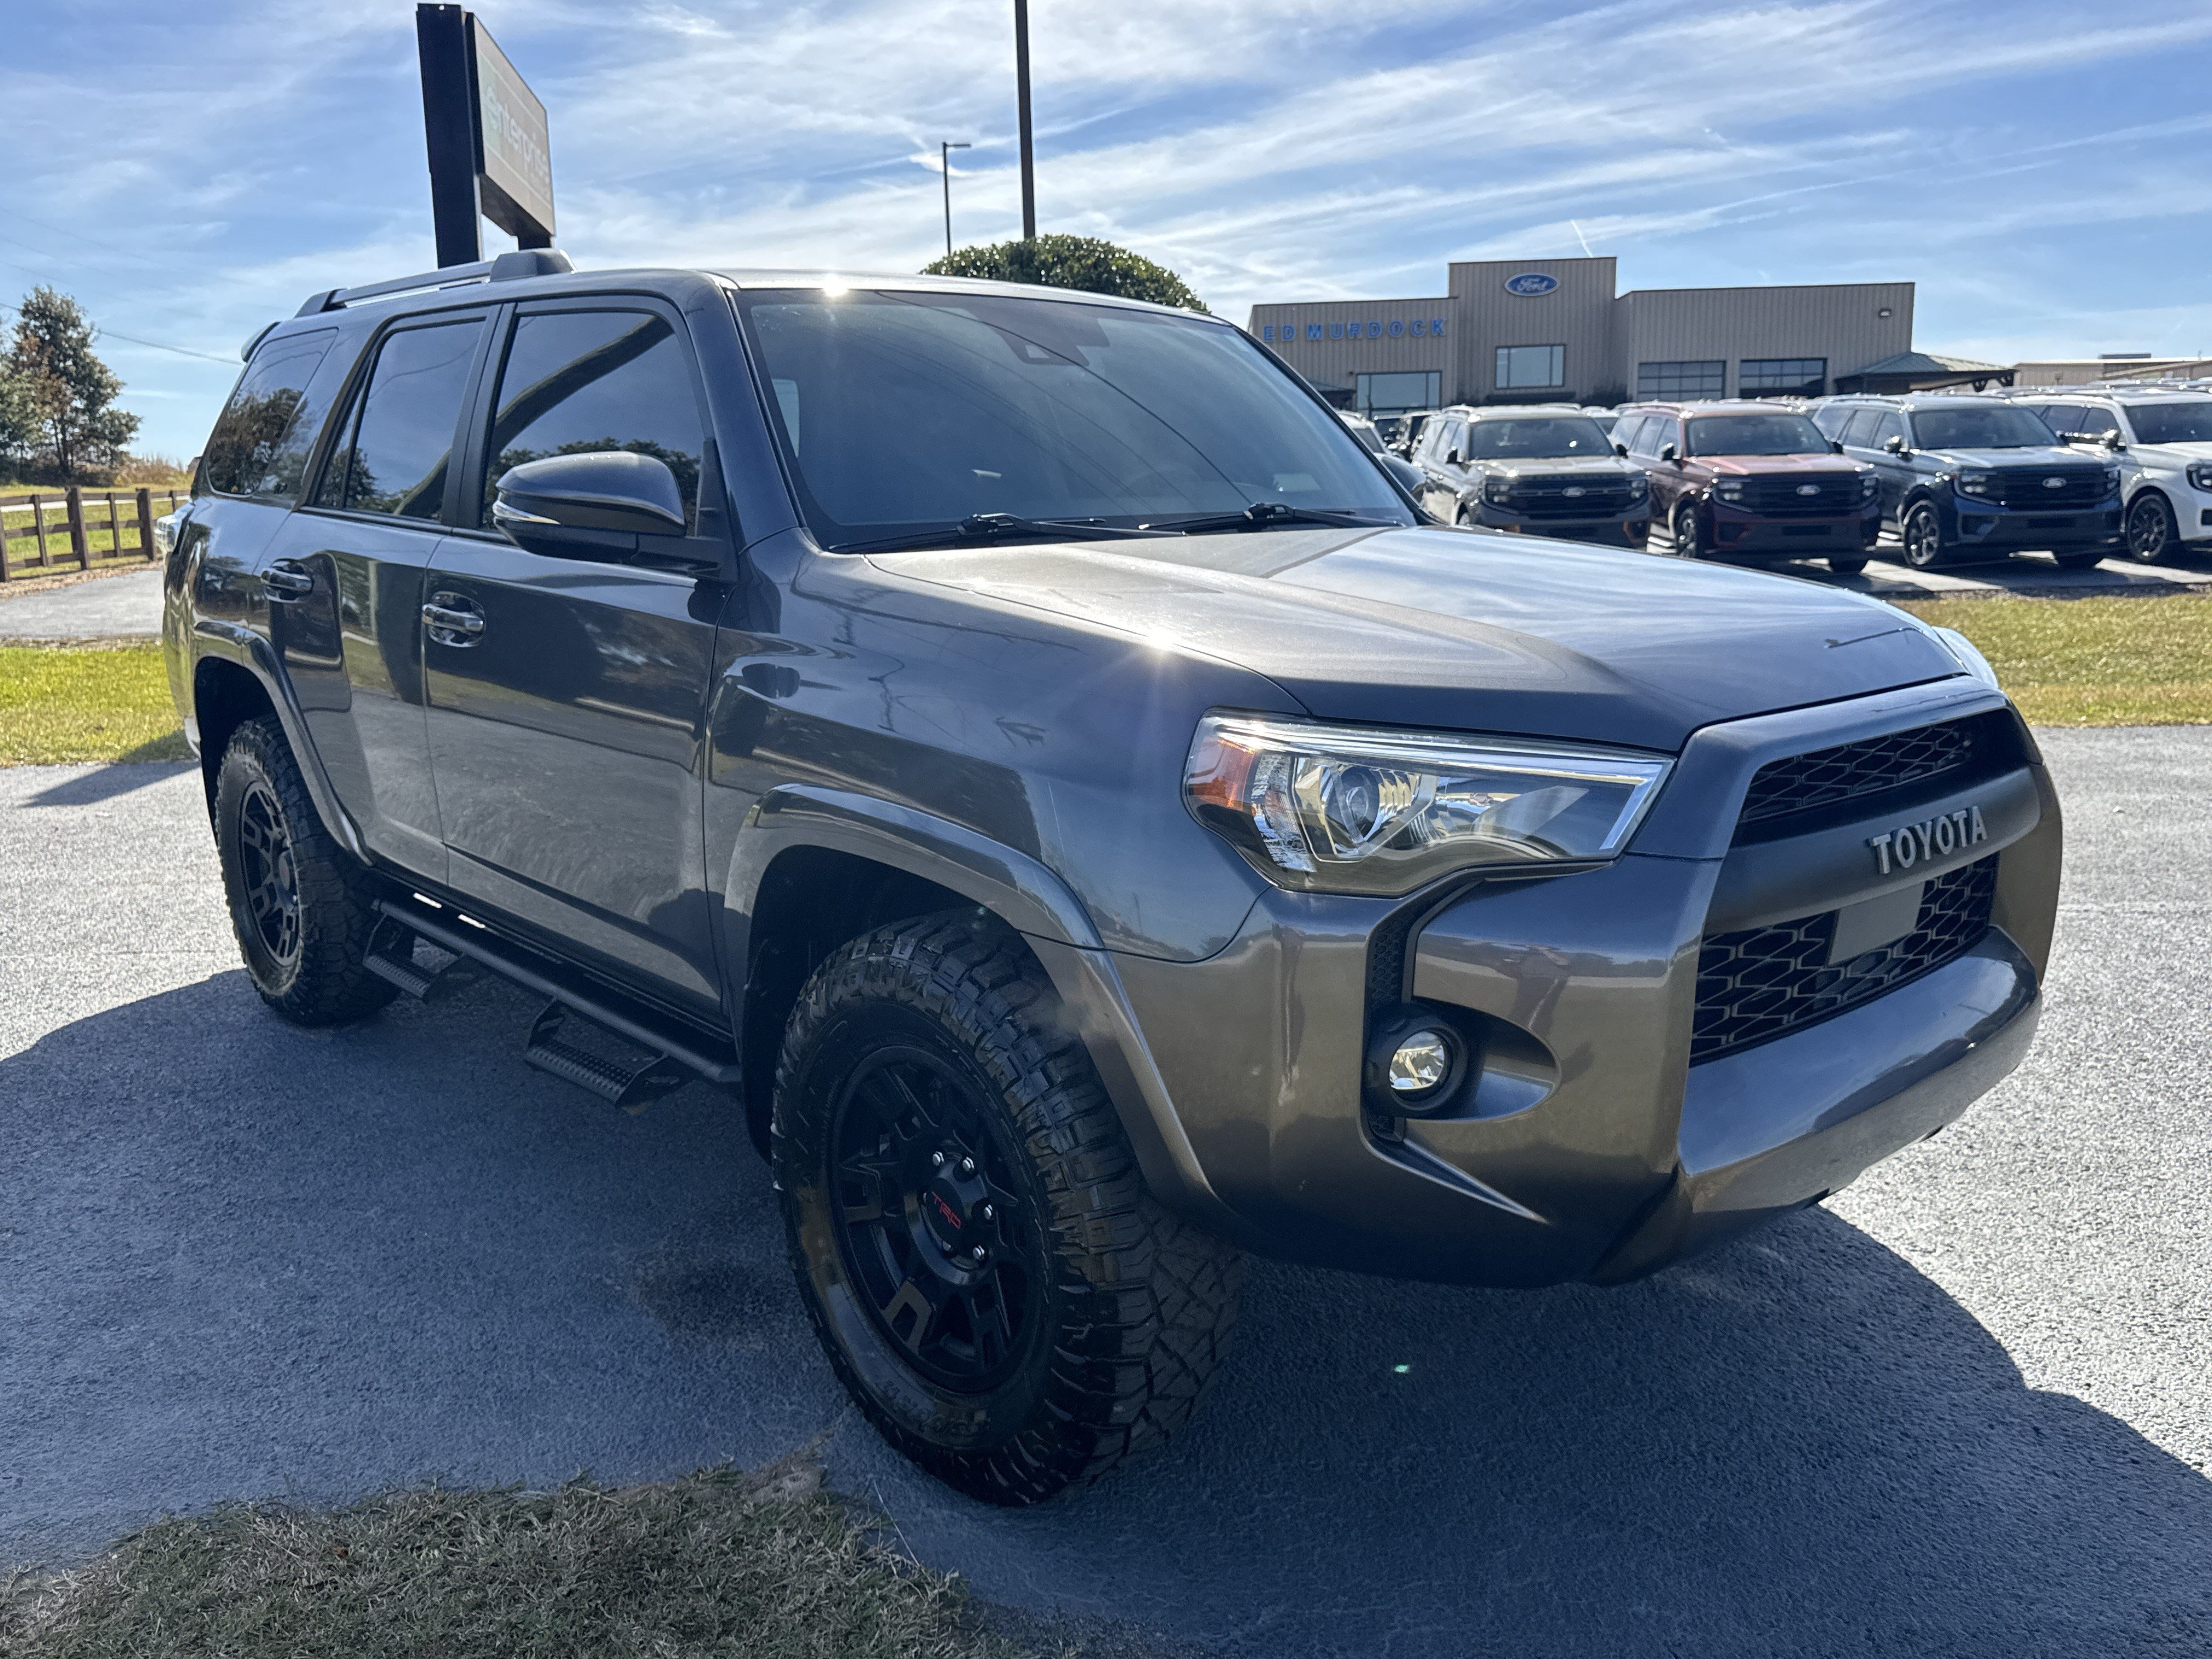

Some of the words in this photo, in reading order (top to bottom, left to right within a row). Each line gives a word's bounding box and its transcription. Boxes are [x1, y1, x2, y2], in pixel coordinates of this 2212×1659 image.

[1517, 278, 1548, 292] Ford
[1263, 324, 1296, 342] ED
[1306, 318, 1446, 341] MURDOCK
[1870, 805, 1988, 874] TOYOTA
[931, 1190, 961, 1229] TRD
